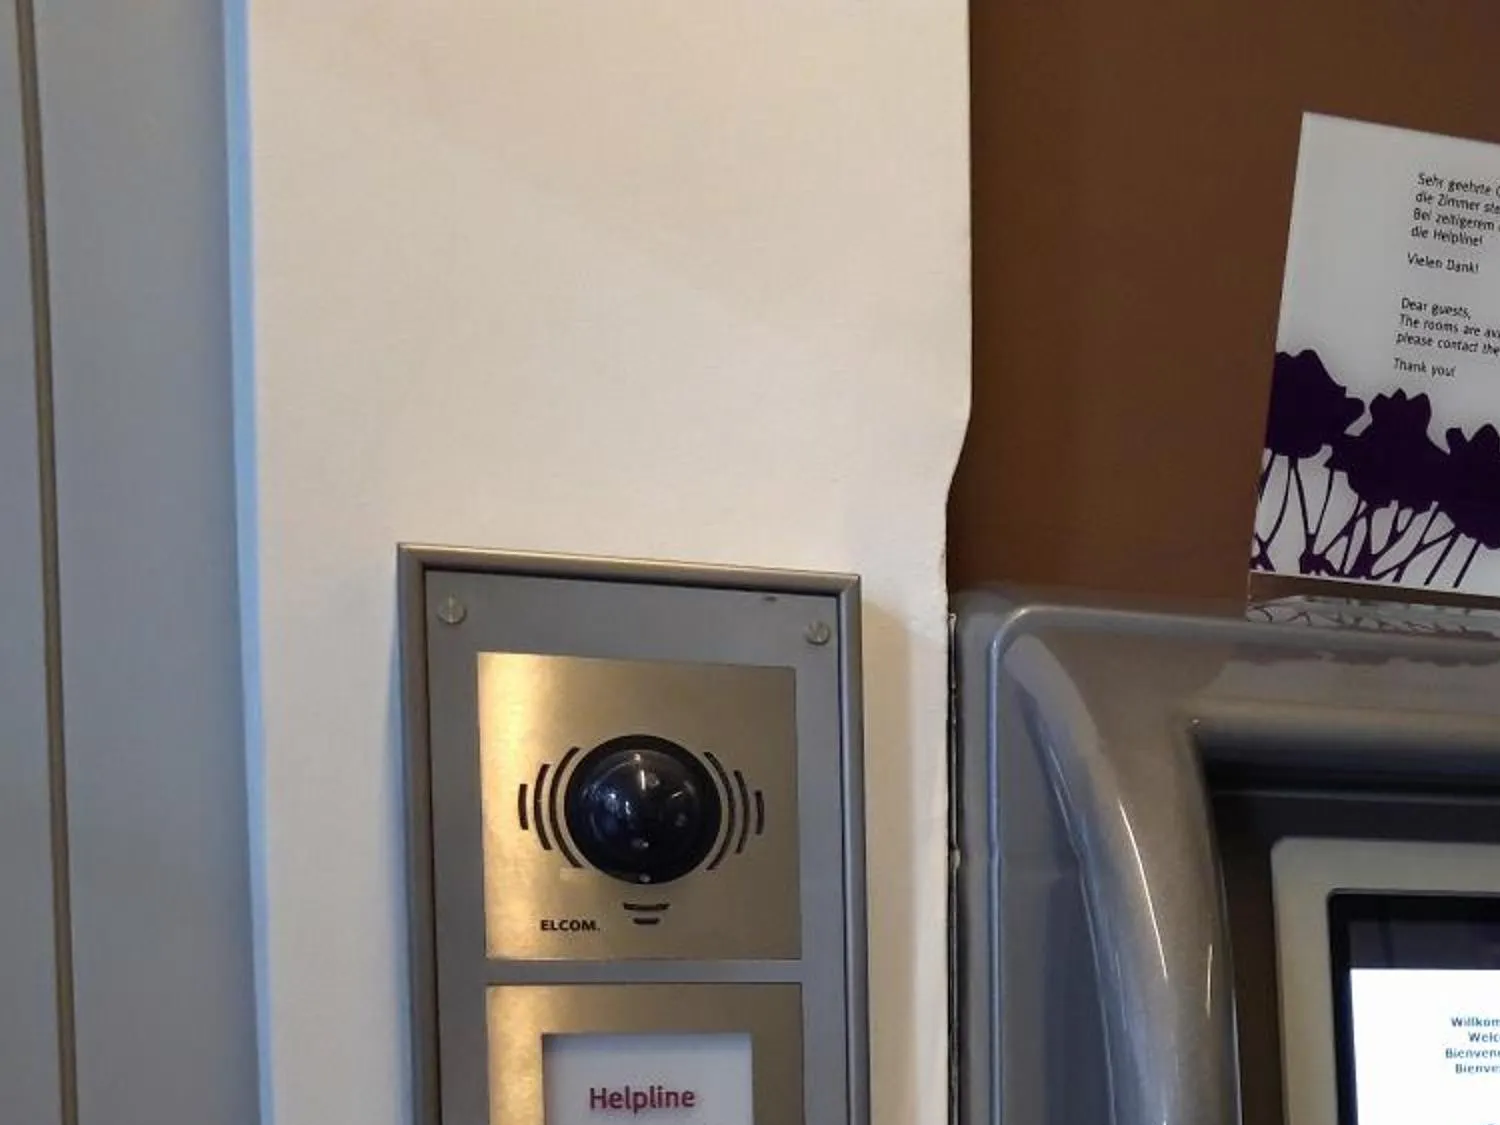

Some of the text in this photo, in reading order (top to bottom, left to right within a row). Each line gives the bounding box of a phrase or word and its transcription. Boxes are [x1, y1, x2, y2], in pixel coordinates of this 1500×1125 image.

[1418, 172, 1444, 188] Sehr
[1415, 190, 1433, 204] die
[1437, 193, 1480, 211] Zimmer
[1413, 207, 1431, 220] Bei
[1411, 225, 1429, 238] die
[1407, 251, 1480, 274] Vielen Dank!
[1401, 297, 1471, 320] Dear guests,
[1399, 313, 1420, 328] The
[1423, 319, 1459, 333] rooms
[1463, 325, 1481, 337] are
[1395, 332, 1433, 347] please
[1437, 337, 1478, 353] contact
[1481, 343, 1500, 357] the
[1394, 356, 1427, 373] Thank
[589, 1086, 695, 1113] Helpline
